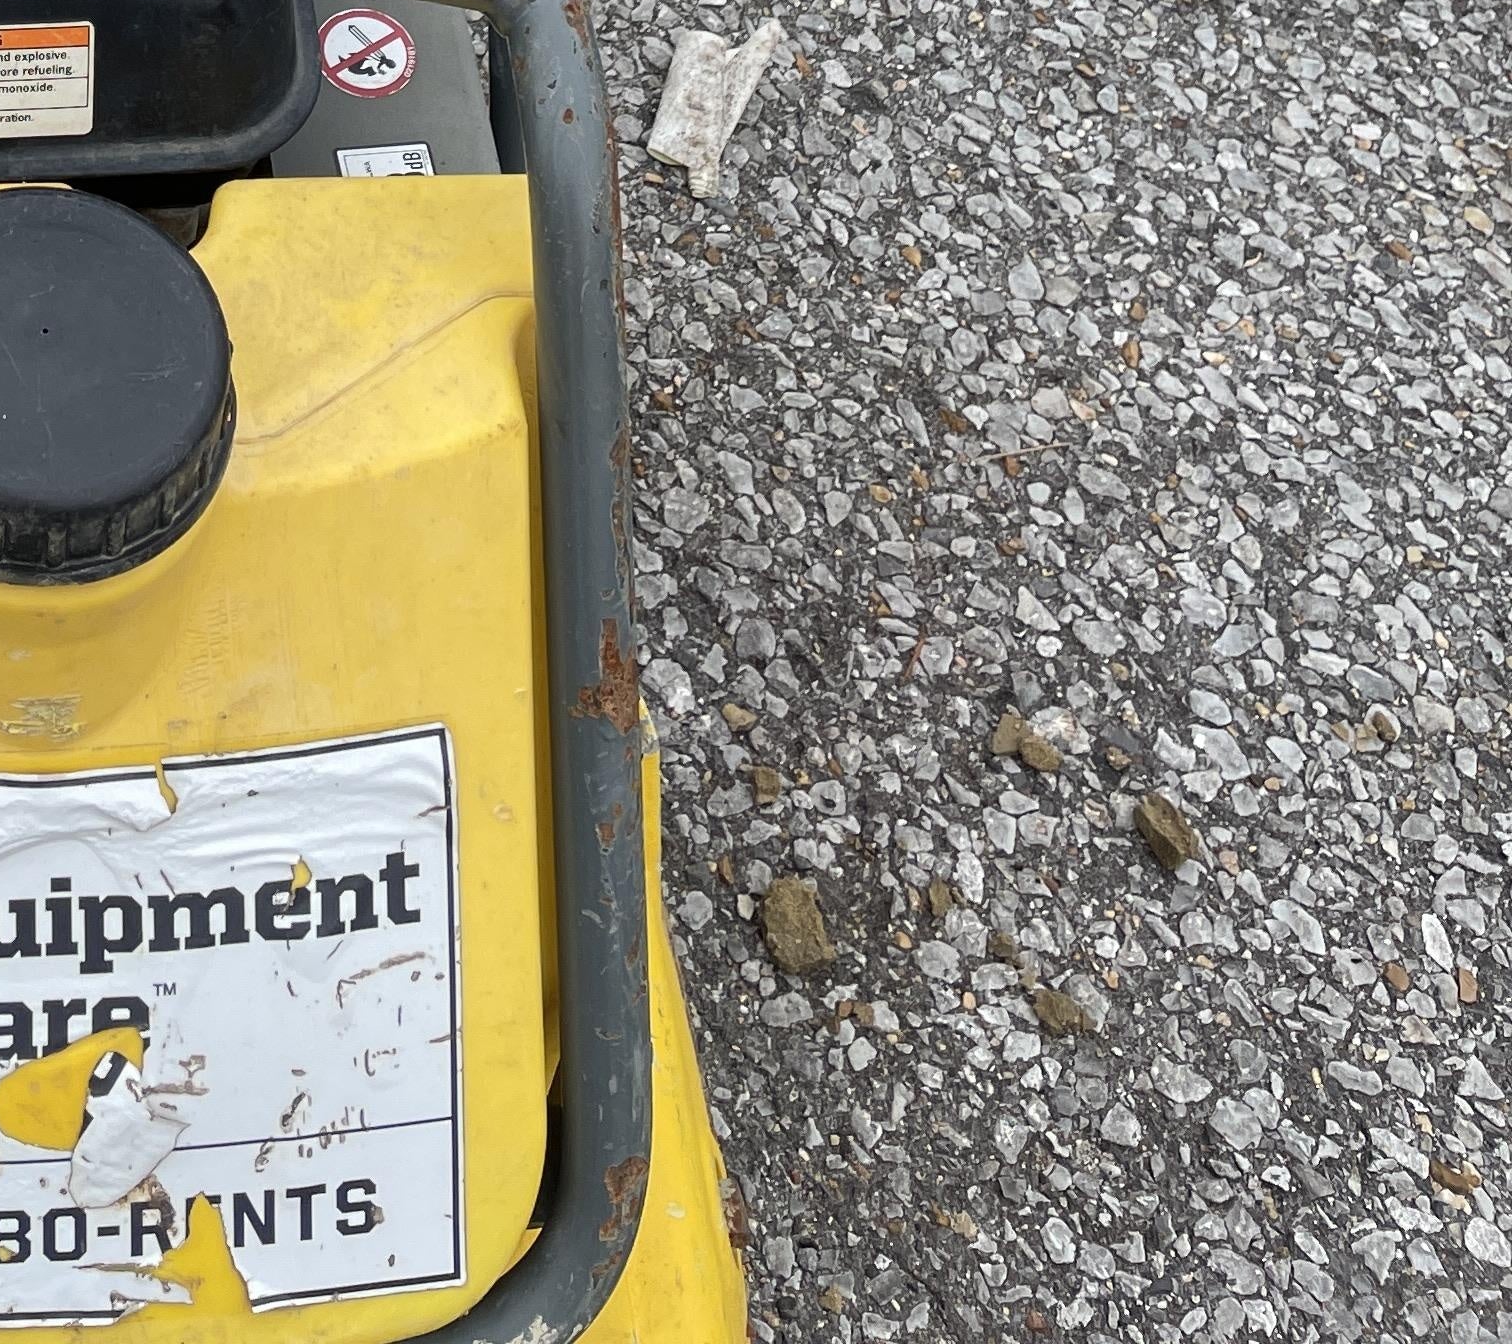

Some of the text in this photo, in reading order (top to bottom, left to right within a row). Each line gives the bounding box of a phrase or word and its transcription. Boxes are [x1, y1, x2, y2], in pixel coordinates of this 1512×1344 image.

[14, 51, 70, 63] explosive.
[22, 65, 75, 77] refueling.
[402, 151, 424, 170] dB
